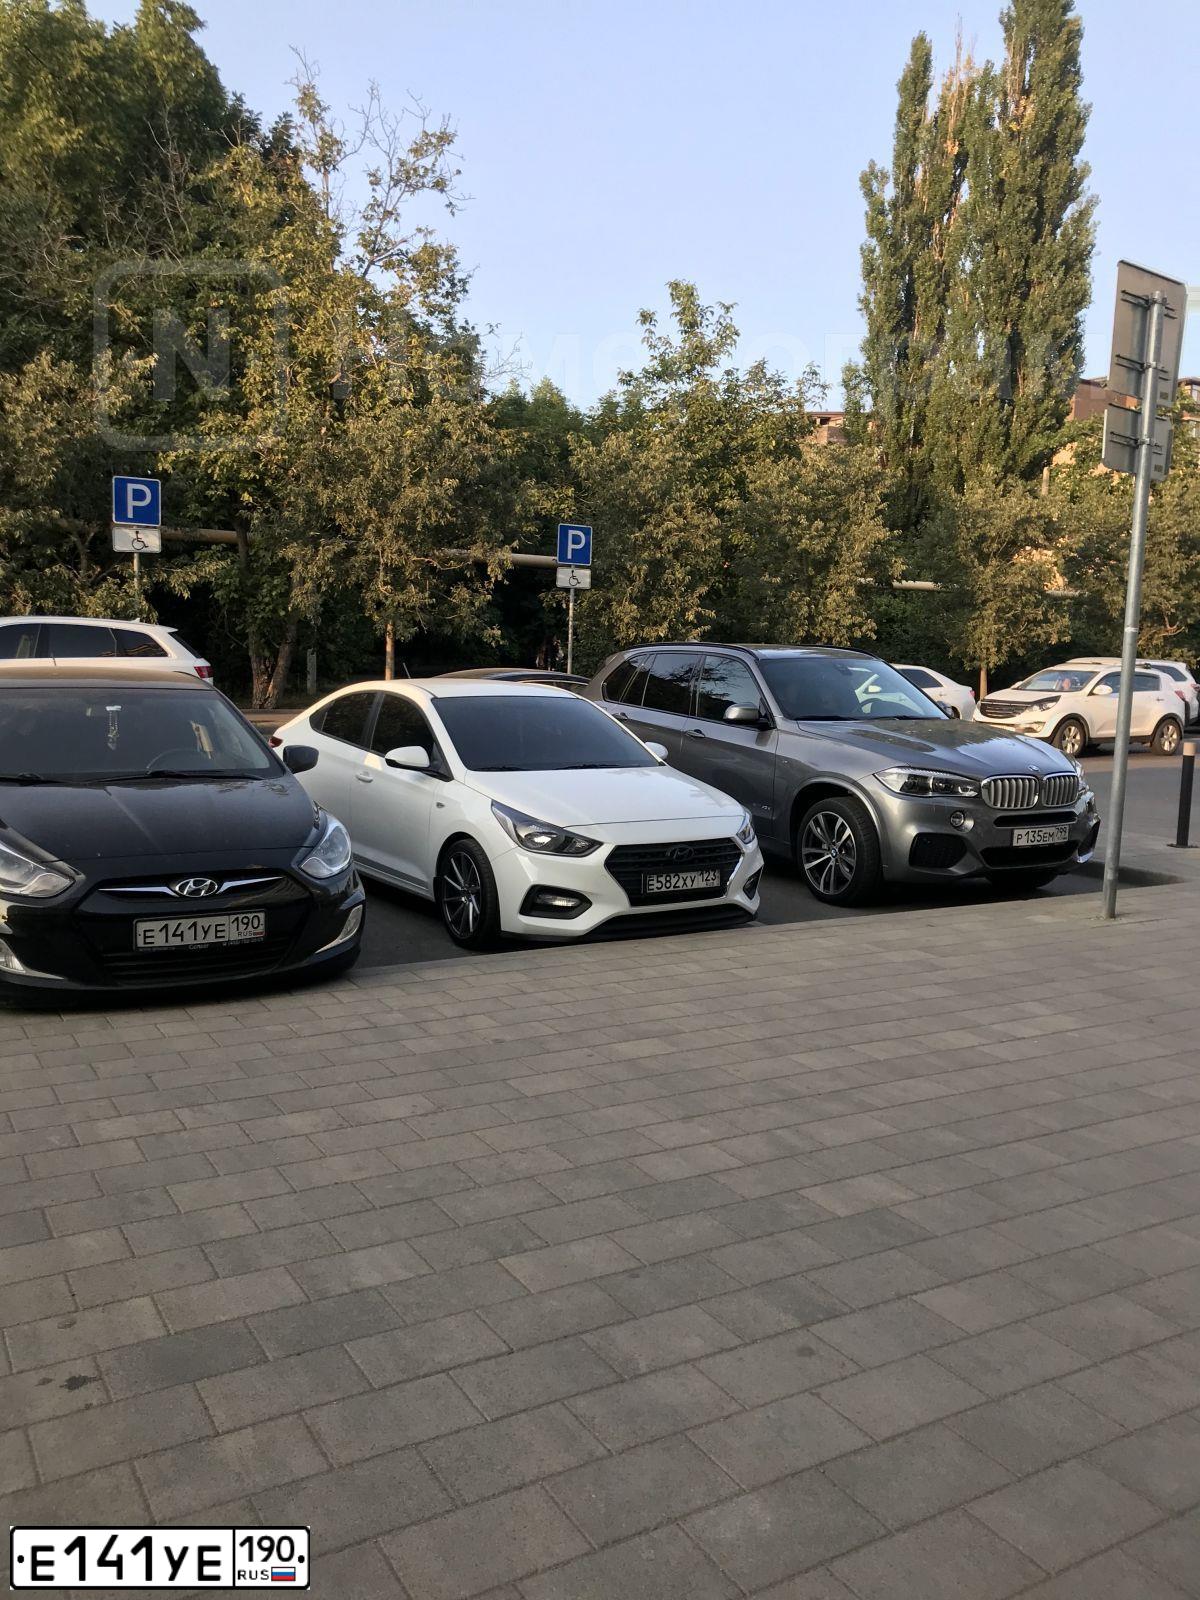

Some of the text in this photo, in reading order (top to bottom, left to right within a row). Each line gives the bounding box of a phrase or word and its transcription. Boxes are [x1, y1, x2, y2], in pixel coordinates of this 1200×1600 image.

[126, 483, 152, 519] P
[567, 529, 586, 560] P
[647, 869, 717, 892] Е582ХУ 123
[143, 920, 226, 945] Е141УЕ
[231, 915, 261, 931] 190
